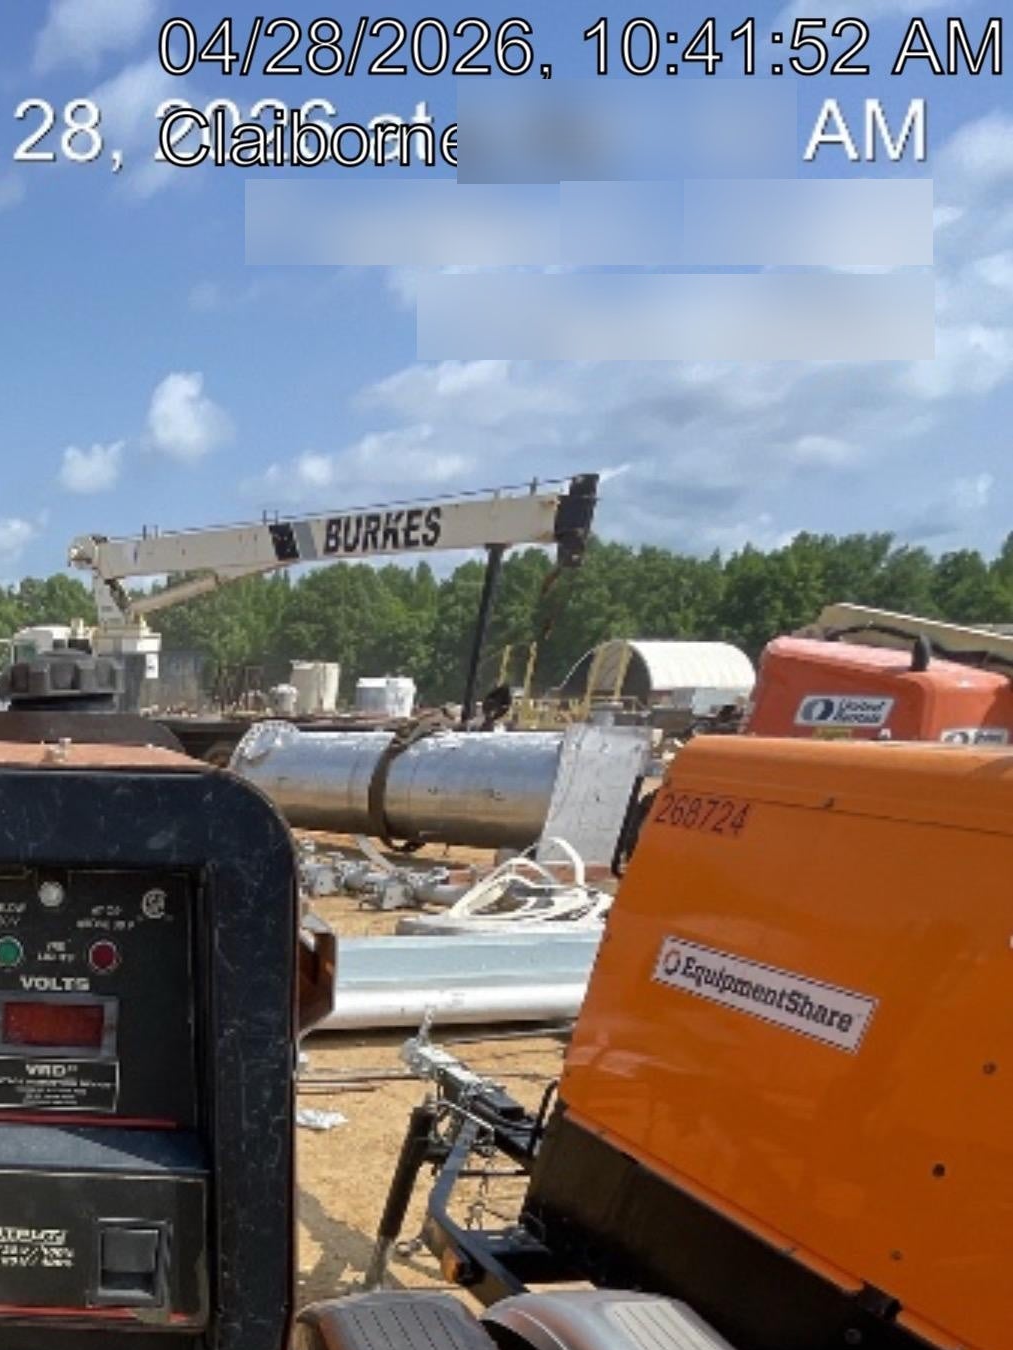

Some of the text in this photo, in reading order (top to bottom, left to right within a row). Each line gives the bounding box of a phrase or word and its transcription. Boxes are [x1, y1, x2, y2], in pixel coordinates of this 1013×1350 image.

[323, 506, 442, 555] BURKES
[654, 794, 751, 837] 268724
[19, 975, 91, 991] VOLTS
[680, 955, 855, 1034] EquipmentShare
